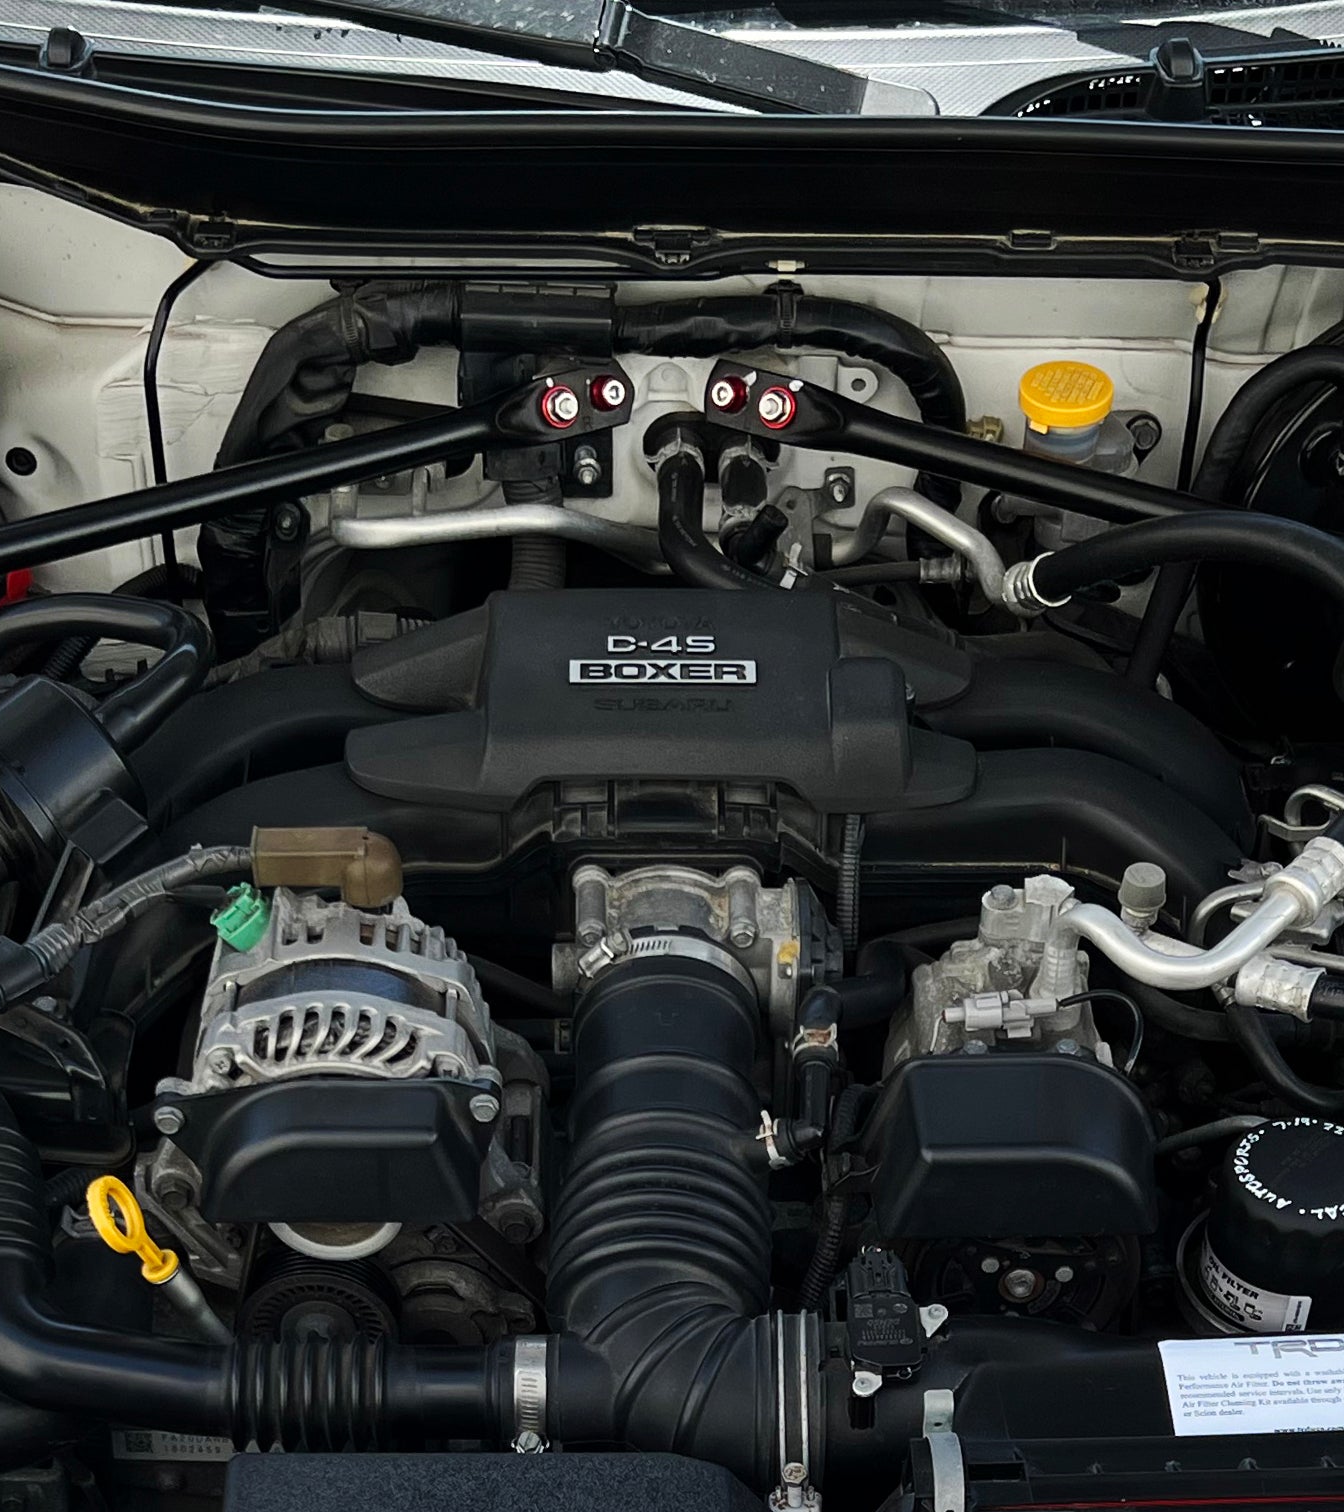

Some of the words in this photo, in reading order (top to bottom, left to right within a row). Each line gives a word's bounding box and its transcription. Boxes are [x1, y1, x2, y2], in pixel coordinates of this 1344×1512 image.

[607, 635, 716, 654] D-4S
[579, 662, 747, 681] BOXER
[1221, 1272, 1260, 1300] FILTER
